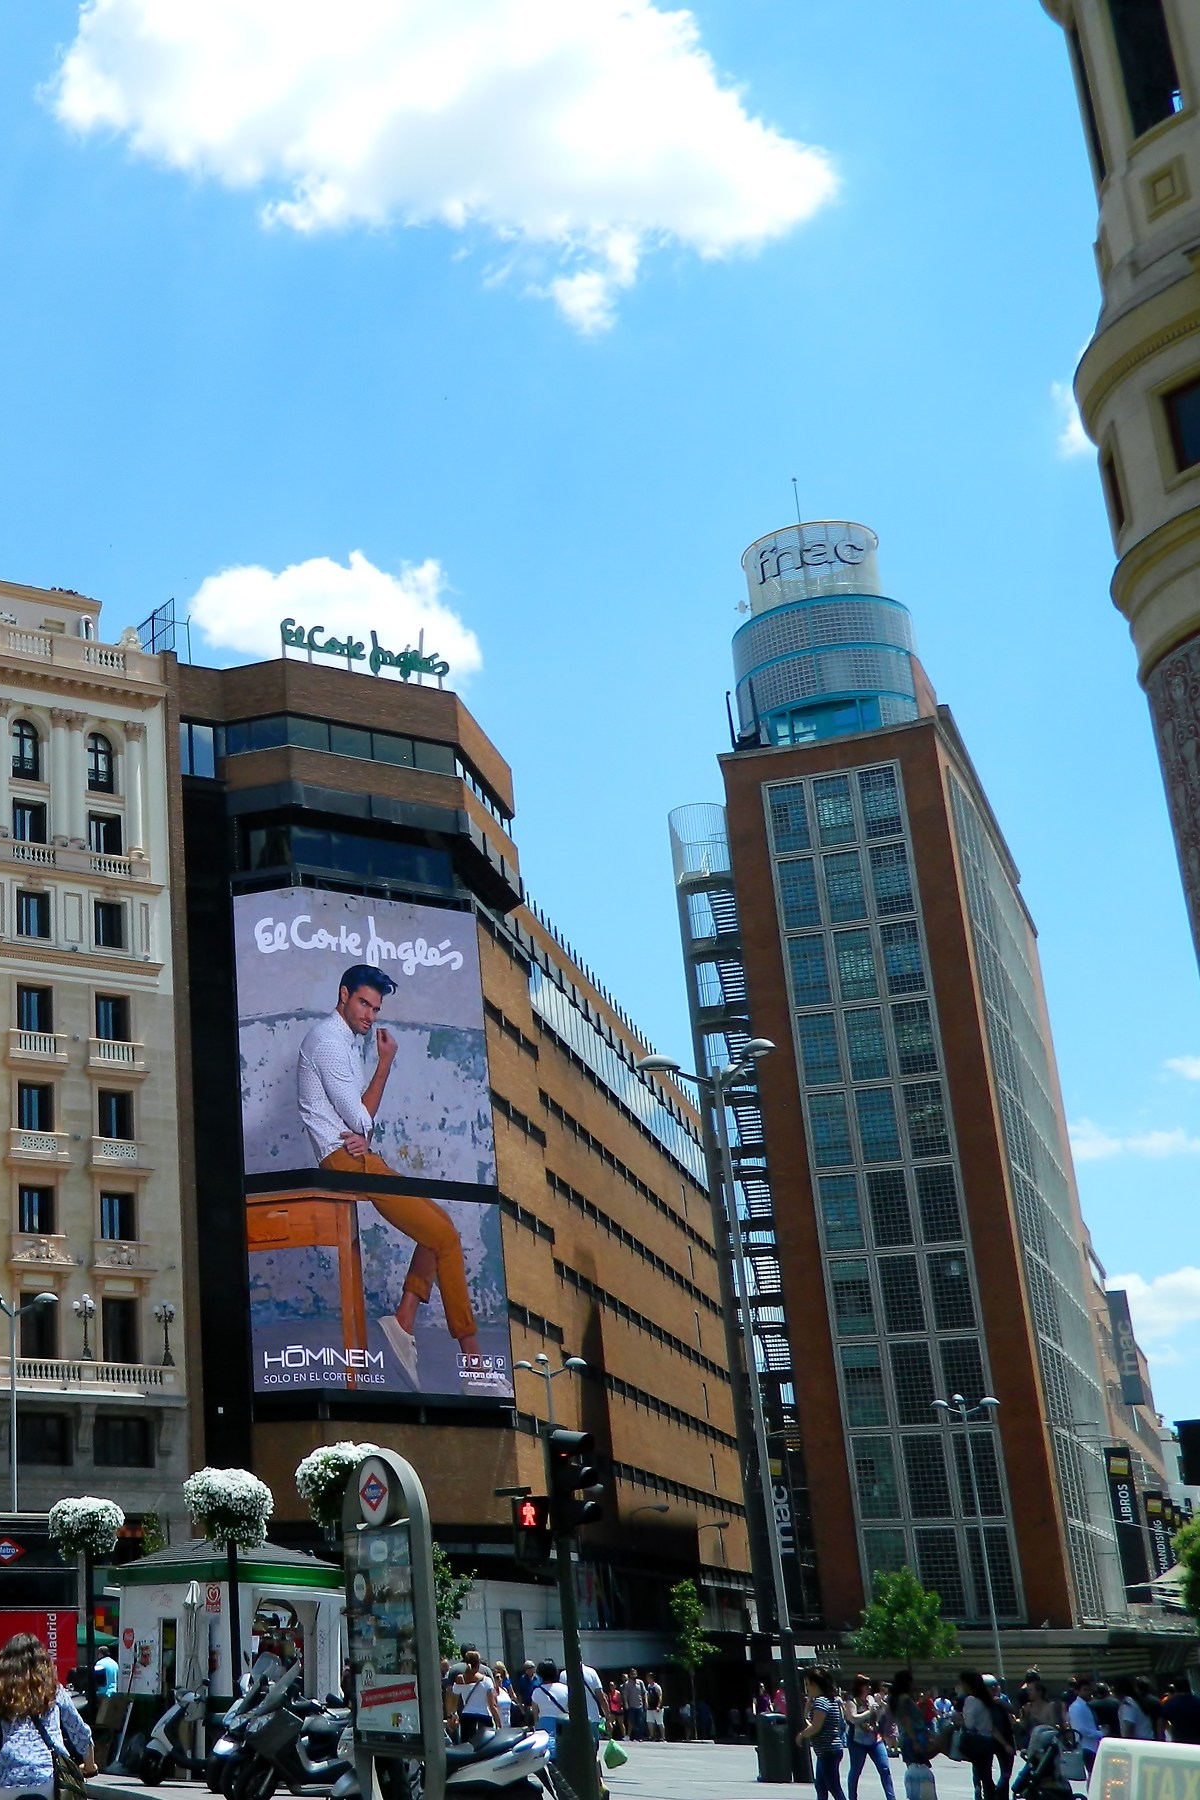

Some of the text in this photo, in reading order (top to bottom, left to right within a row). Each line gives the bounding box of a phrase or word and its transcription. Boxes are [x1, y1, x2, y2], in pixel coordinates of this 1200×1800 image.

[757, 540, 866, 585] fnac
[280, 618, 450, 680] El Corte Inglés
[254, 915, 464, 976] El Corte Inglés
[263, 1374, 291, 1384] SOLO
[293, 1373, 307, 1382] EN
[309, 1372, 321, 1381] EL
[322, 1371, 352, 1382] CORTE
[459, 1371, 485, 1380] compra
[1117, 1483, 1134, 1524] LIBROS
